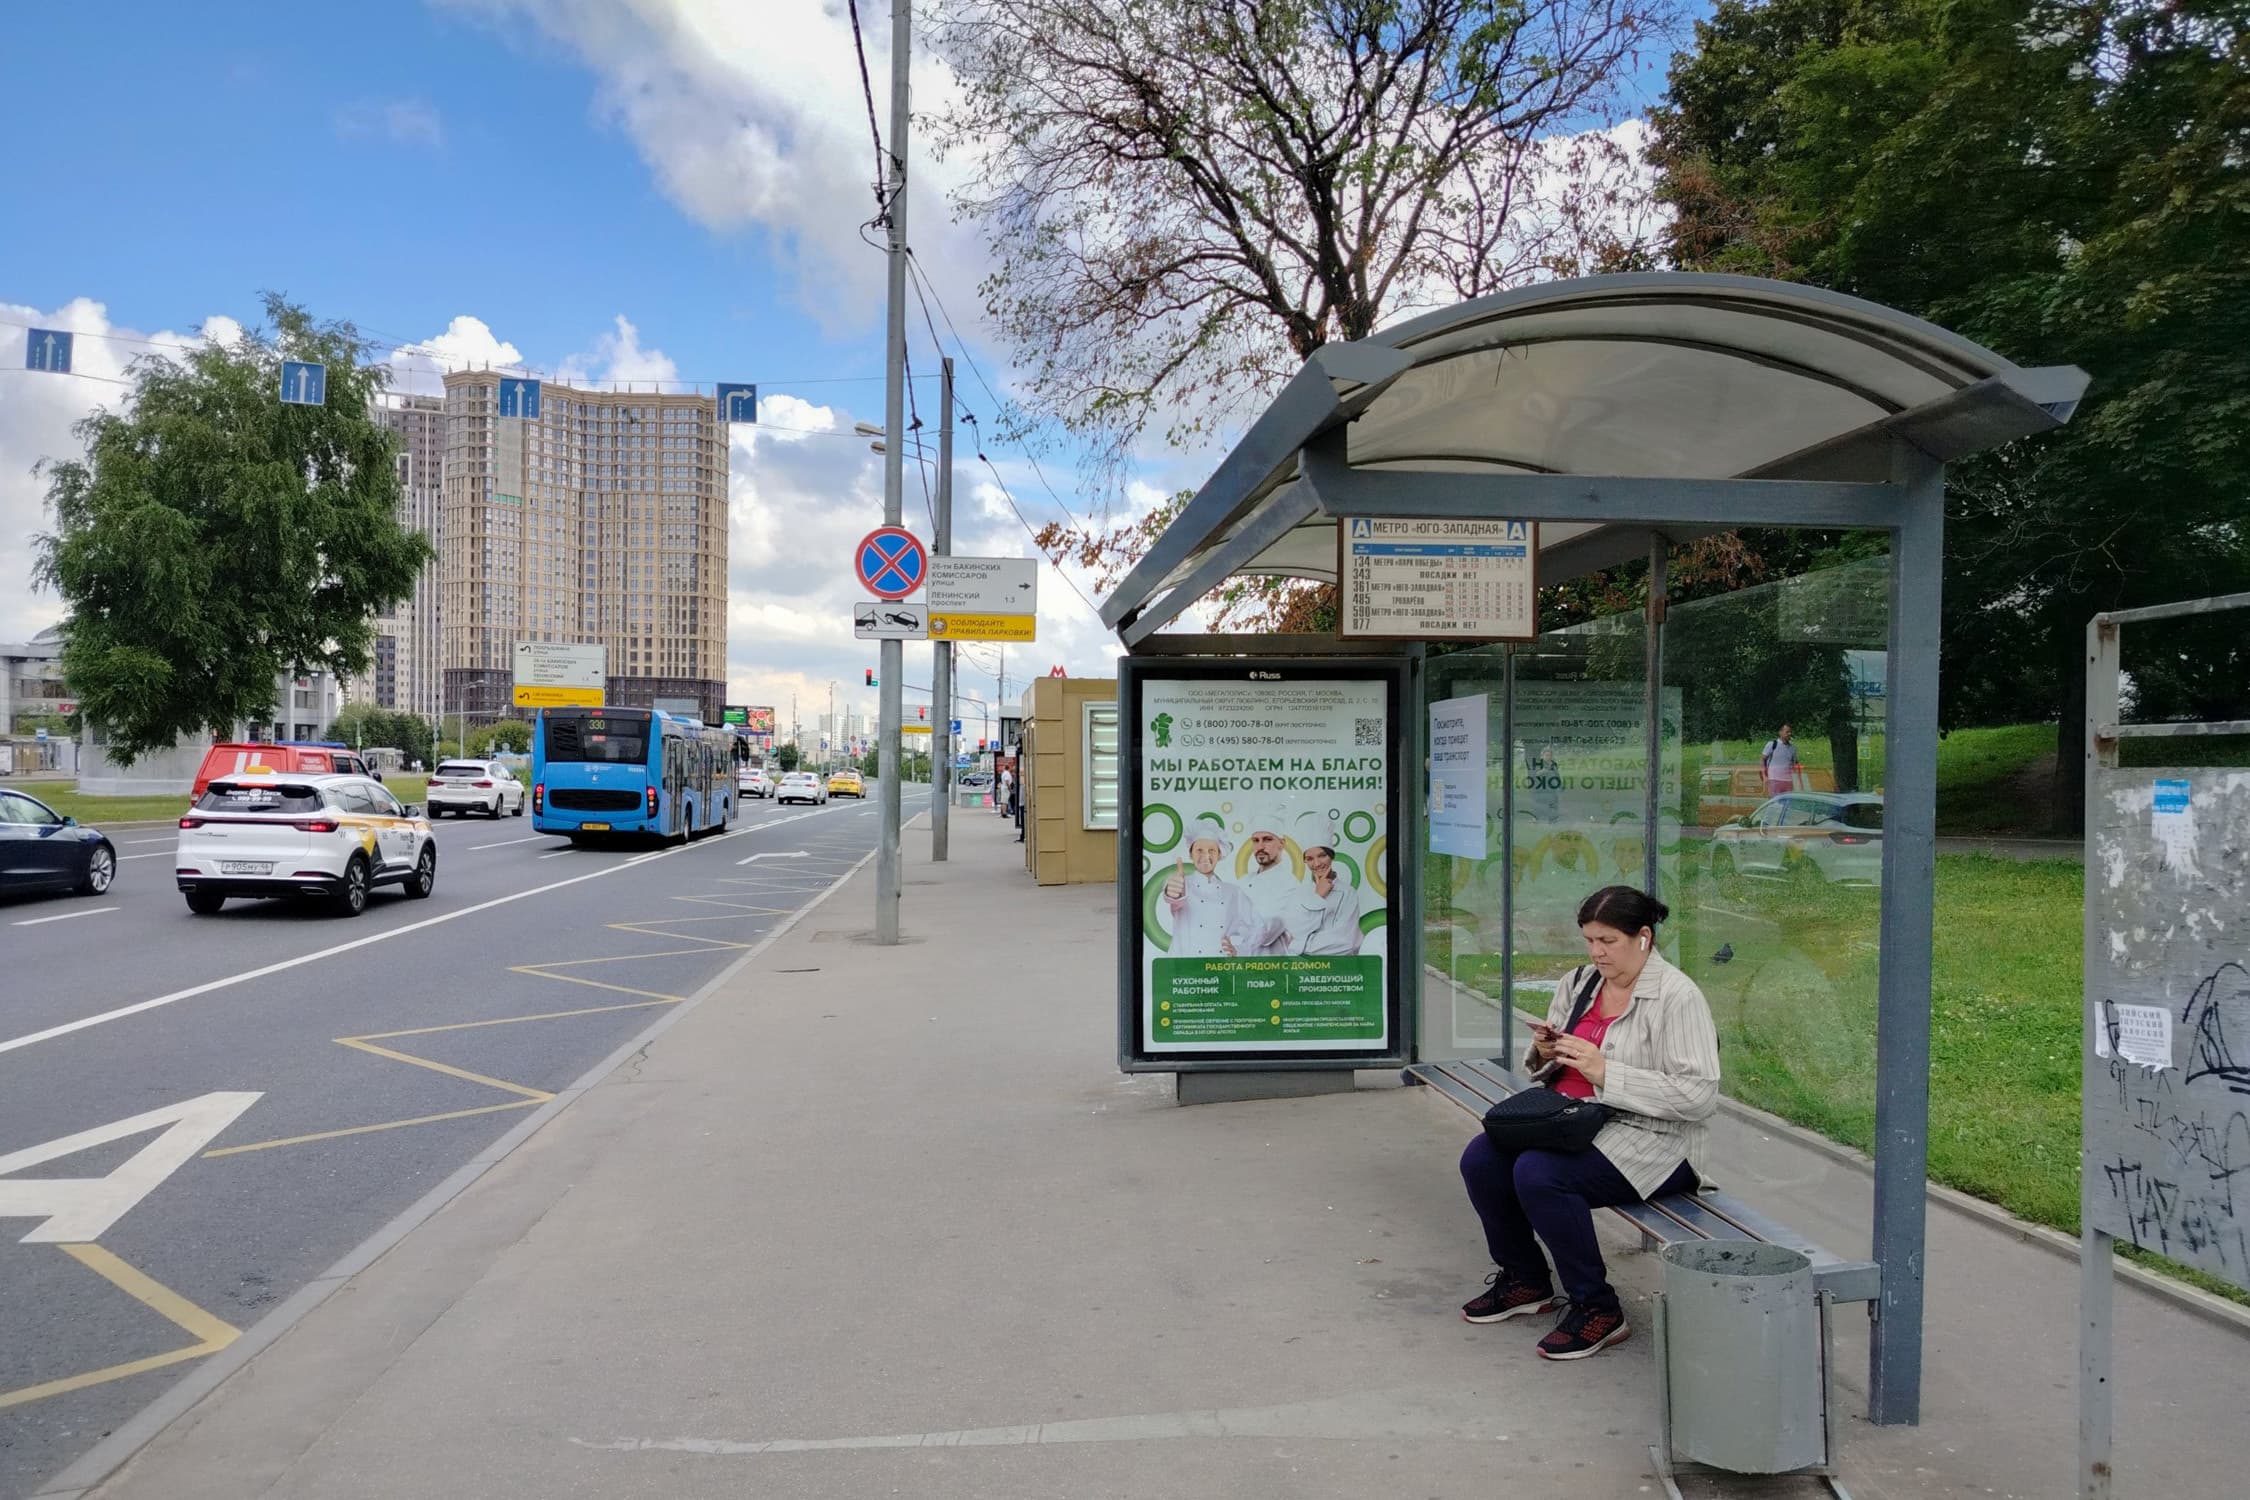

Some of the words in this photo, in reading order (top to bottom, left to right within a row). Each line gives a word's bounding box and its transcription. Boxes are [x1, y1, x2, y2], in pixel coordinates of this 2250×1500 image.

[1374, 522, 1409, 534] МЕТРО
[954, 563, 1001, 571] БАКИНСКИХ
[1374, 558, 1394, 567] МЕТРО
[1353, 568, 1371, 580] 343
[1463, 571, 1477, 579] НЕТ
[1353, 581, 1370, 592] 361
[931, 591, 980, 599] ЛЕНИНСКИЙ
[950, 619, 1005, 627] СОБЛЮДАЙТЕ
[1353, 618, 1370, 630] 877
[1463, 621, 1477, 629] НЕТ
[1259, 671, 1281, 680] Russ
[589, 719, 605, 730] 330
[1203, 720, 1228, 728] (800)
[1230, 719, 1273, 728] 700-78-01
[1216, 736, 1240, 745] (495)
[1242, 736, 1284, 745] 580-78-01
[1151, 758, 1182, 772] МЫ
[1188, 758, 1284, 772] РАБОТАЕМ
[1290, 758, 1315, 772] НА
[1322, 757, 1382, 772] БЛАГО
[1151, 777, 1254, 792] БУДУЩЕГО
[1260, 776, 1382, 791] ПОКОЛЕНИЯ!
[1205, 963, 1243, 971] РАБОТА
[1245, 962, 1281, 971] РЯДОМ
[1291, 961, 1331, 970] ДОМОМ
[1172, 976, 1219, 985] КУХОННЫЙ
[1299, 974, 1364, 984] ЗАВЕДУЮЩИЙ
[1247, 980, 1276, 988] ПОВАР
[1298, 984, 1364, 993] ПРОИЗВОДСТВОМ
[1172, 986, 1219, 995] РАБОТНИК
